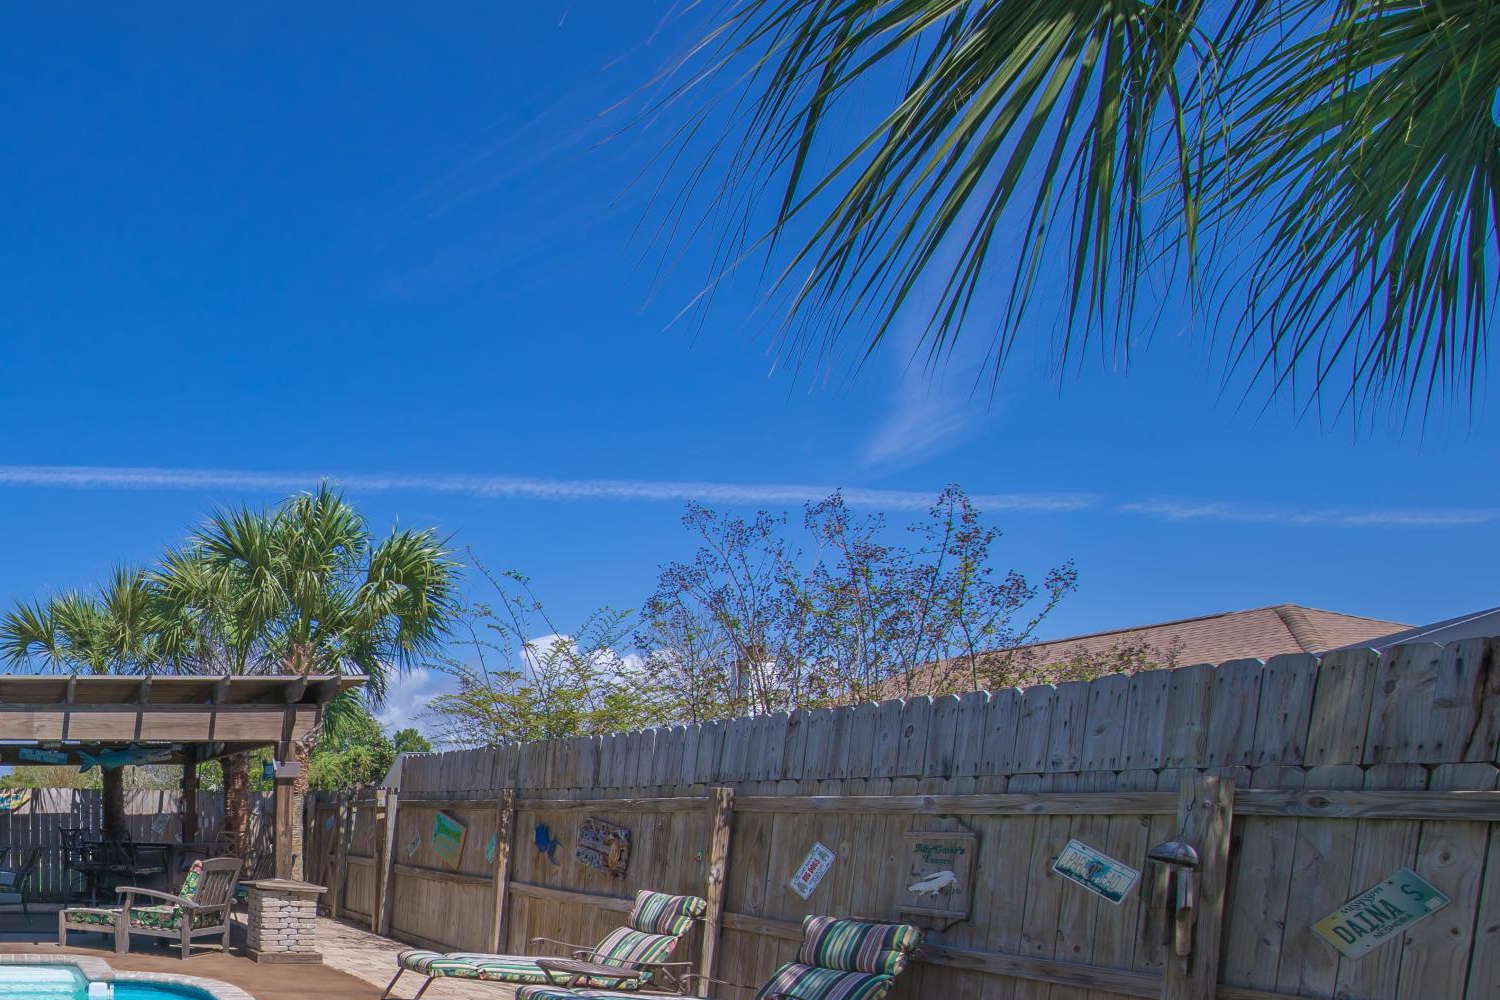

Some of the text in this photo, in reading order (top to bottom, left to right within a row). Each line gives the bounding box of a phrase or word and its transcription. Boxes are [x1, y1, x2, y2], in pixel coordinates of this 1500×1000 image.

[808, 857, 821, 874] DOGS
[1332, 884, 1424, 944] DAINA S
